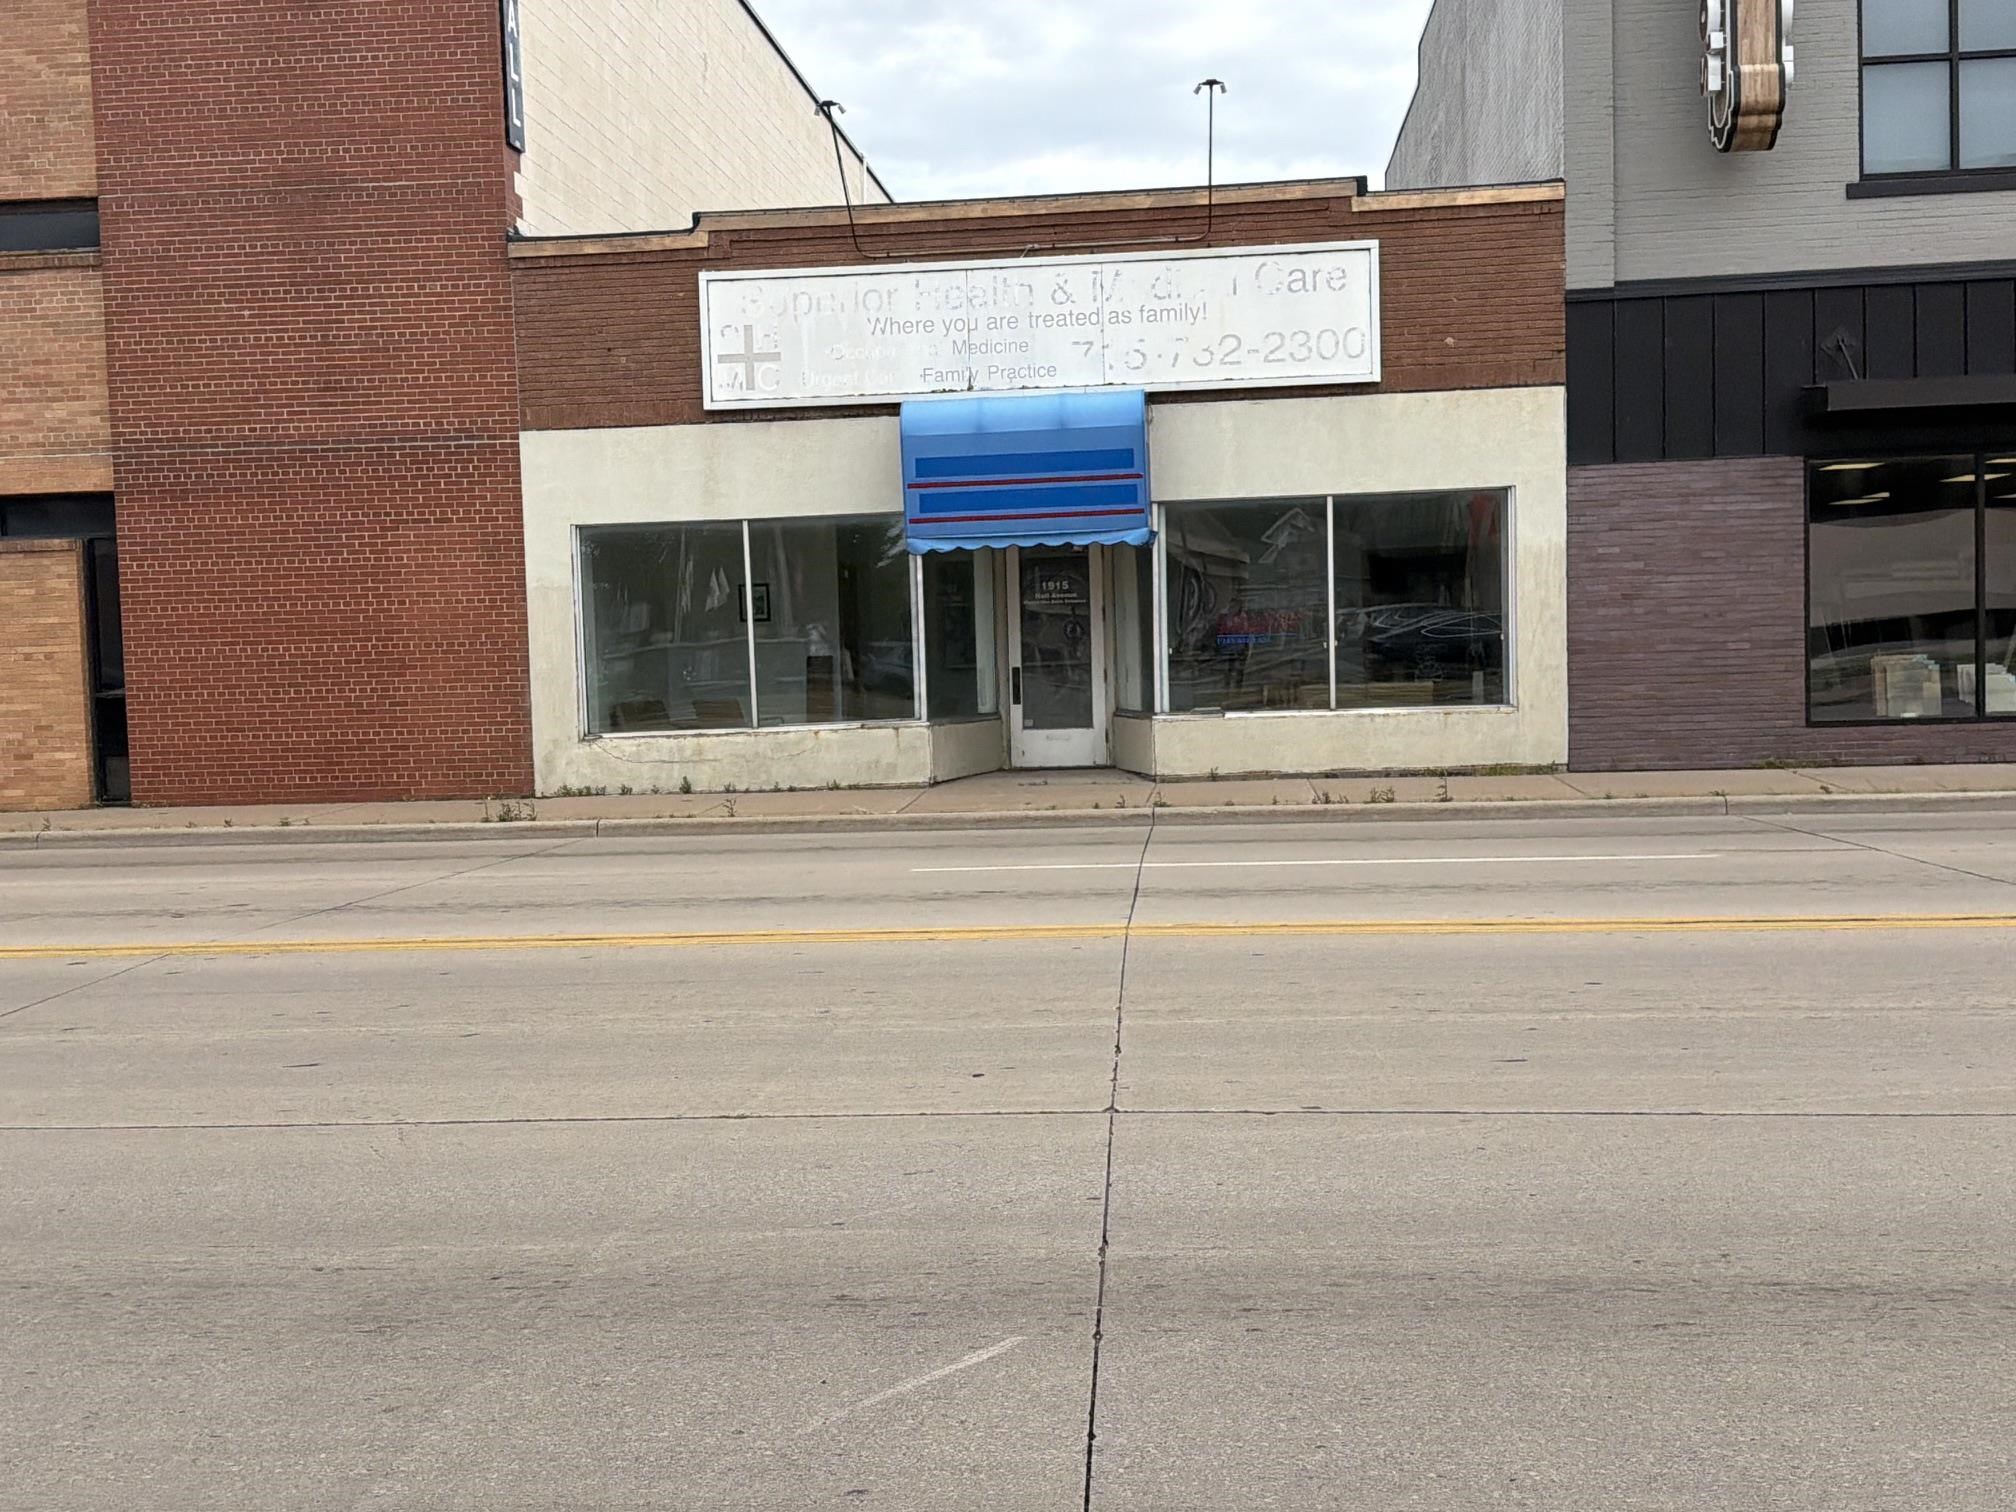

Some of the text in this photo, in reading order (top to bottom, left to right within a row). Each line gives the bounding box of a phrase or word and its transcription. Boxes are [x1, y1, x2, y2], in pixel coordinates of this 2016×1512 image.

[1051, 272, 1076, 305] &
[1255, 261, 1347, 295] Care
[867, 301, 1207, 337] Where you are treated as family!
[952, 338, 1029, 355] Medicine
[987, 363, 1057, 381] Practice
[1042, 581, 1069, 590] 1915
